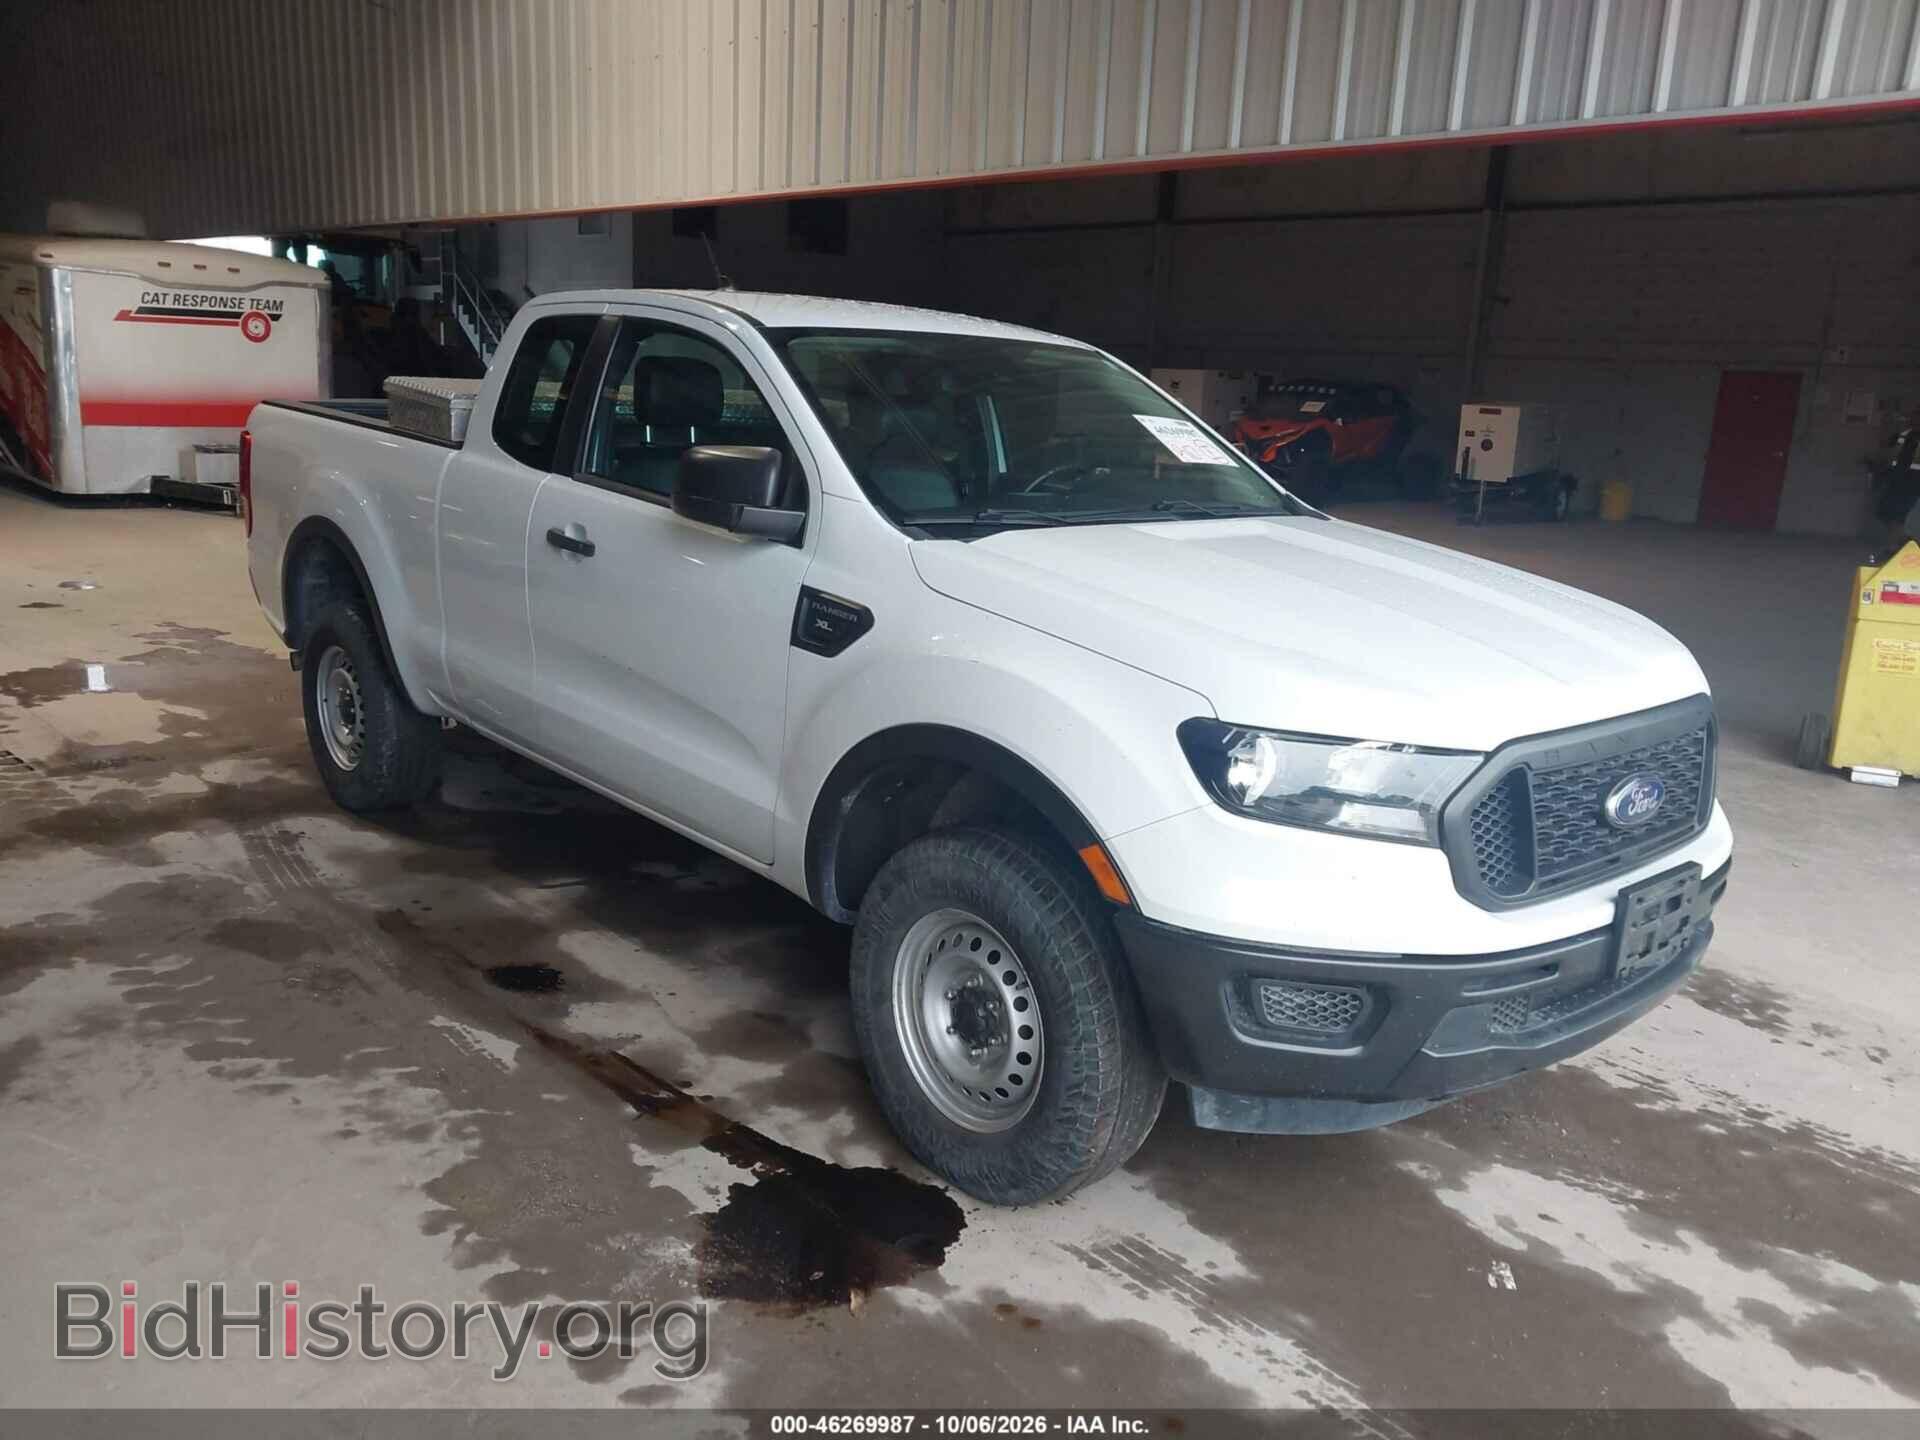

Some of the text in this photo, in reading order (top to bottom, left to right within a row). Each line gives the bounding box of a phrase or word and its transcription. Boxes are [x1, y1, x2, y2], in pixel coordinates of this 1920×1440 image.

[141, 291, 284, 312] CAT RESPONSE TEAM
[815, 619, 833, 632] XL
[1628, 786, 1659, 816] Ford
